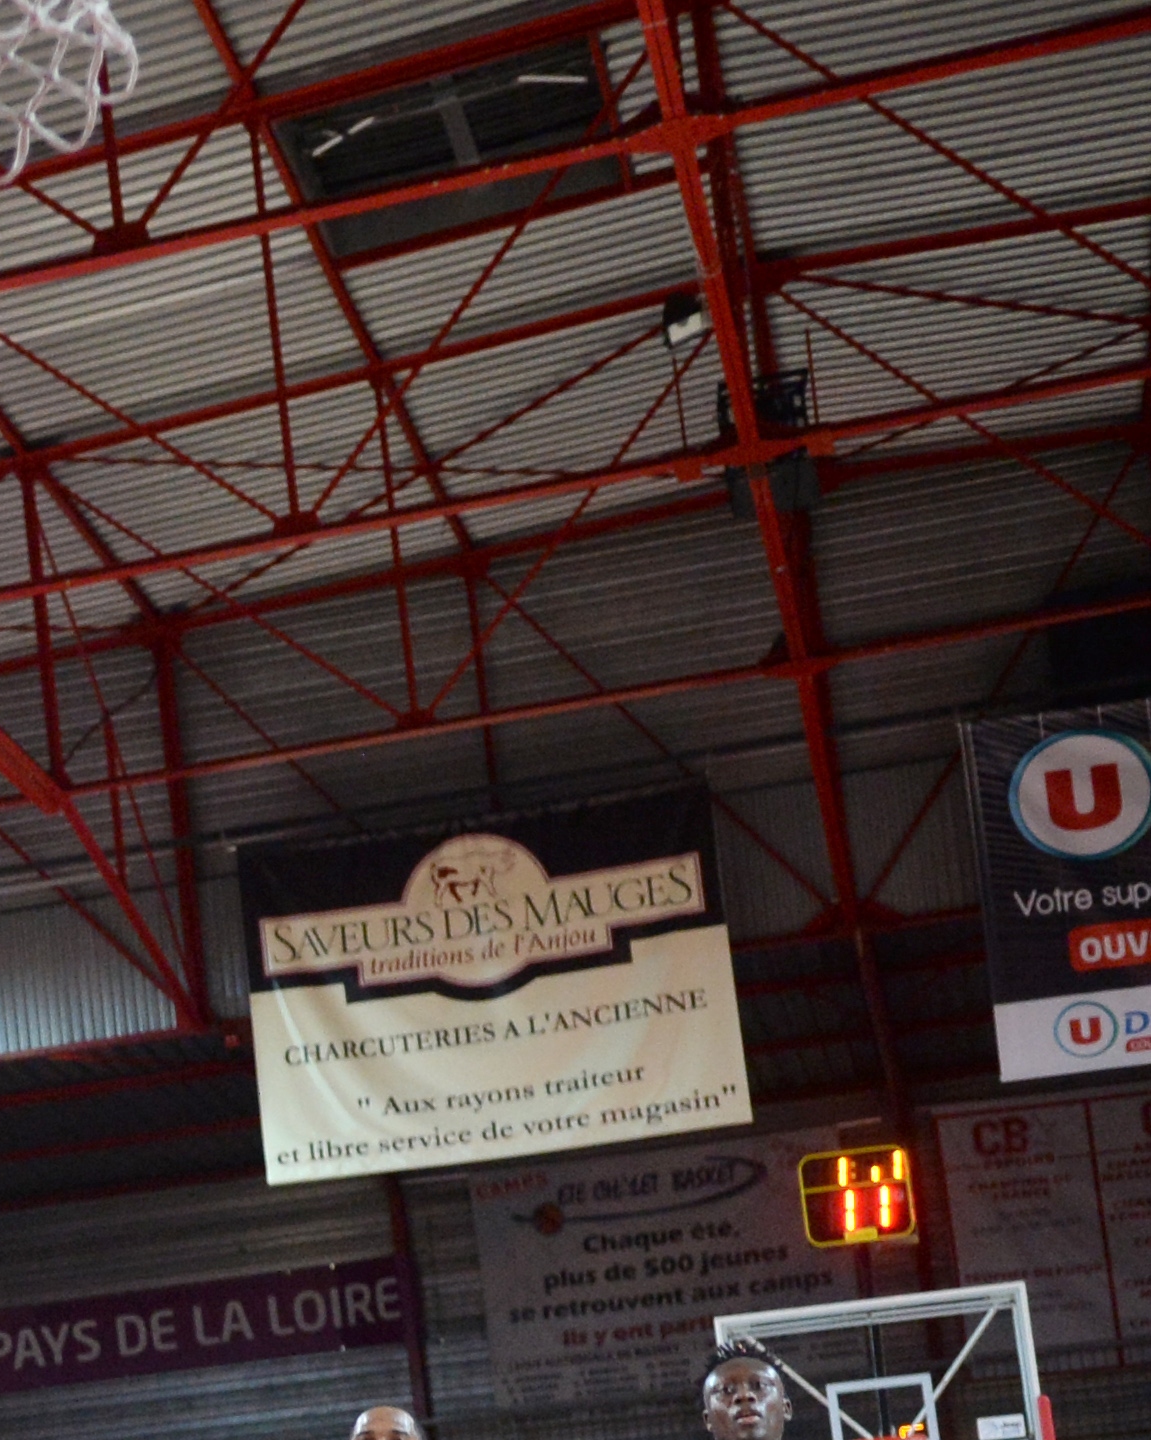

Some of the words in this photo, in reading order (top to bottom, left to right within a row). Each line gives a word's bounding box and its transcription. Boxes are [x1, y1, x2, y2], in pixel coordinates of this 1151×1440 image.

[443, 903, 514, 940] DES
[524, 864, 693, 934] MAUGES
[1013, 883, 1093, 918] Votre
[1102, 880, 1151, 911] sup
[369, 945, 475, 976] traditions
[481, 939, 507, 961] de
[514, 925, 598, 956] l'Anjou
[1079, 930, 1151, 964] OUV
[284, 1022, 496, 1066] CHARCUTERIES
[503, 1016, 522, 1040] A
[526, 988, 708, 1036] L'ANCIENNE
[383, 1093, 438, 1117] Aux
[447, 1083, 536, 1117] rayons
[544, 1063, 646, 1097] traiteur
[276, 1149, 300, 1167] et
[309, 1136, 370, 1162] libre
[378, 1126, 472, 1153] service
[481, 1119, 515, 1143] de
[525, 1110, 591, 1136] votre
[582, 1227, 683, 1254] Chaque
[543, 1269, 596, 1294] plus
[604, 1262, 637, 1283] de
[645, 1254, 695, 1279] 500
[700, 1245, 789, 1277] jeunes
[116, 1309, 178, 1358] DE
[193, 1300, 254, 1347] LA
[267, 1277, 403, 1336] LOIRE
[508, 1305, 537, 1324] se
[542, 1287, 686, 1320] retrouvent
[692, 1283, 741, 1303] aux
[748, 1268, 835, 1296] camps
[613, 1323, 654, 1342] ont
[659, 1313, 715, 1340] parti
